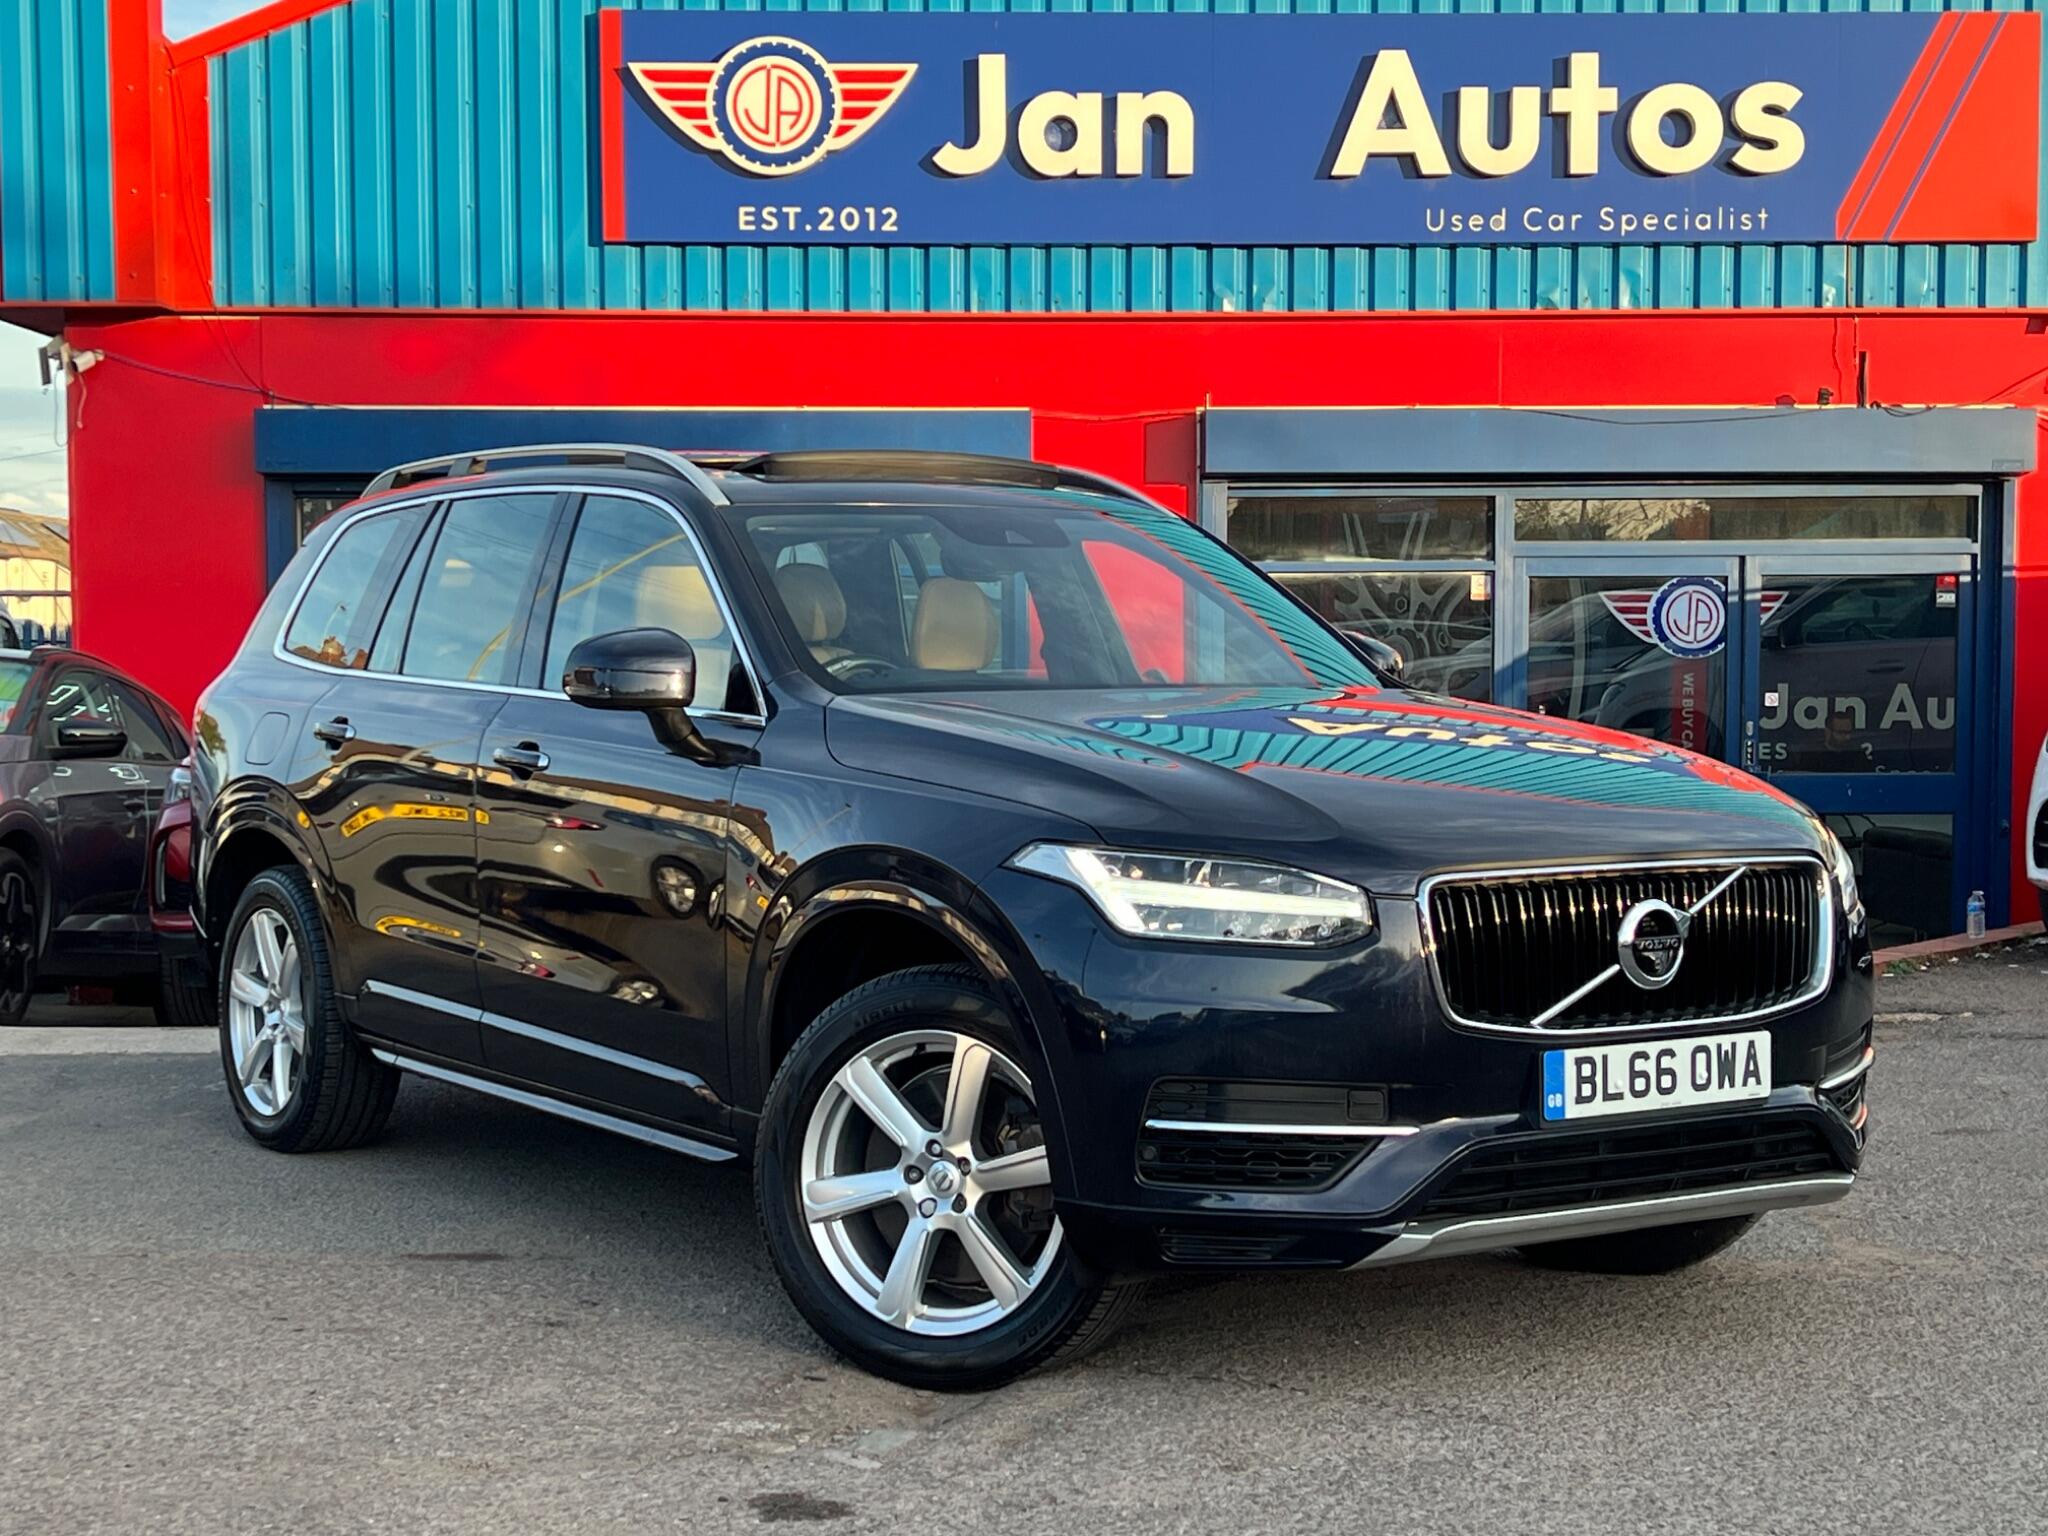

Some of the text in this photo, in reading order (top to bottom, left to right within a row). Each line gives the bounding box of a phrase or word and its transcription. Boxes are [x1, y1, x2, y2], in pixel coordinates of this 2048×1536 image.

[932, 49, 1806, 177] Jan Autos
[738, 206, 899, 232] EST.2012
[1425, 206, 1770, 237] Used Car Specialist
[1682, 672, 1695, 696] WE
[1681, 698, 1695, 727] BUY
[1758, 682, 1866, 730] Jan
[1634, 937, 1680, 950] VOLVO
[1573, 1038, 1763, 1105] BL66 OWA
[1547, 1092, 1563, 1108] GB
